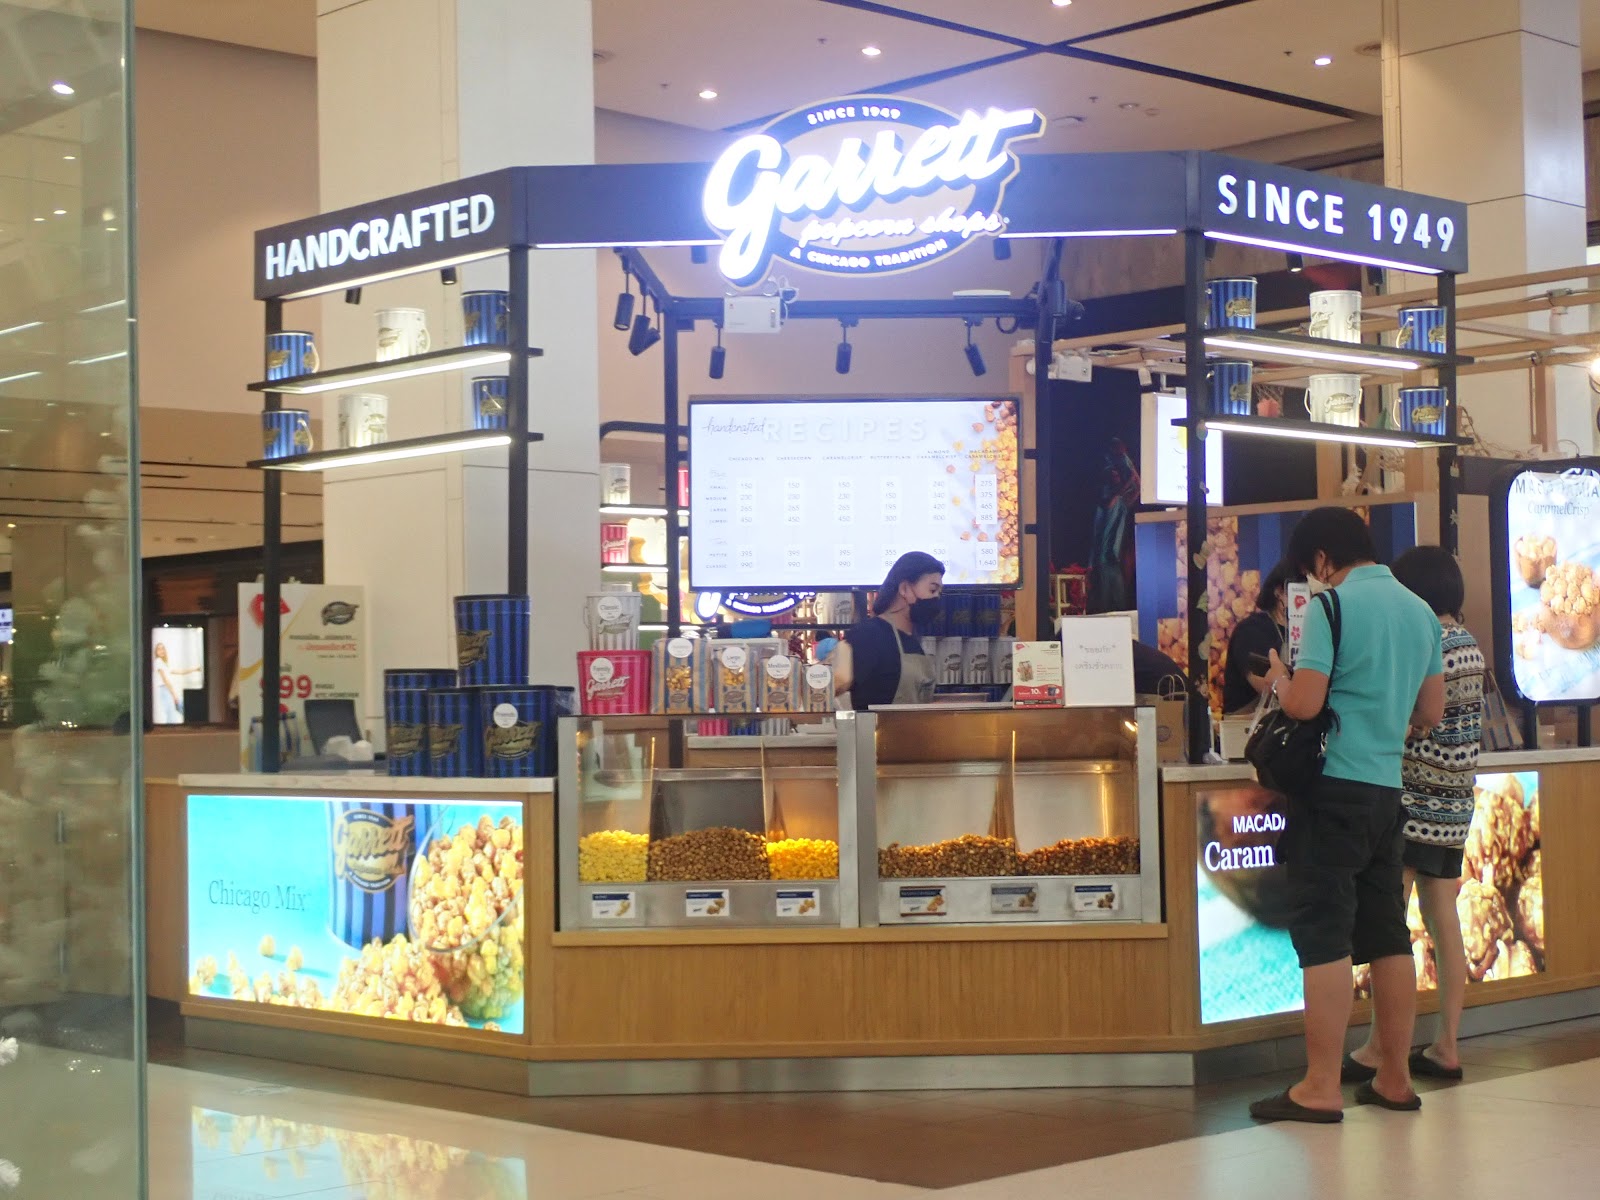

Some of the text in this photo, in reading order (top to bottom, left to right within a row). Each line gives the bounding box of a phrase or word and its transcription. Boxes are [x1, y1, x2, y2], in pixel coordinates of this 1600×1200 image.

[807, 106, 901, 125] SINCE 1949
[703, 107, 1035, 280] Garrett
[1217, 174, 1455, 252] SINCE 1949
[265, 193, 495, 281] HANDCRAFTED
[799, 206, 1001, 247] popcorn shops
[789, 238, 949, 269] A CHICAGO TRADITION
[702, 415, 927, 444] handcrafted RECIPES
[333, 814, 415, 879] Garrett
[208, 879, 306, 915] Chicago Mix
